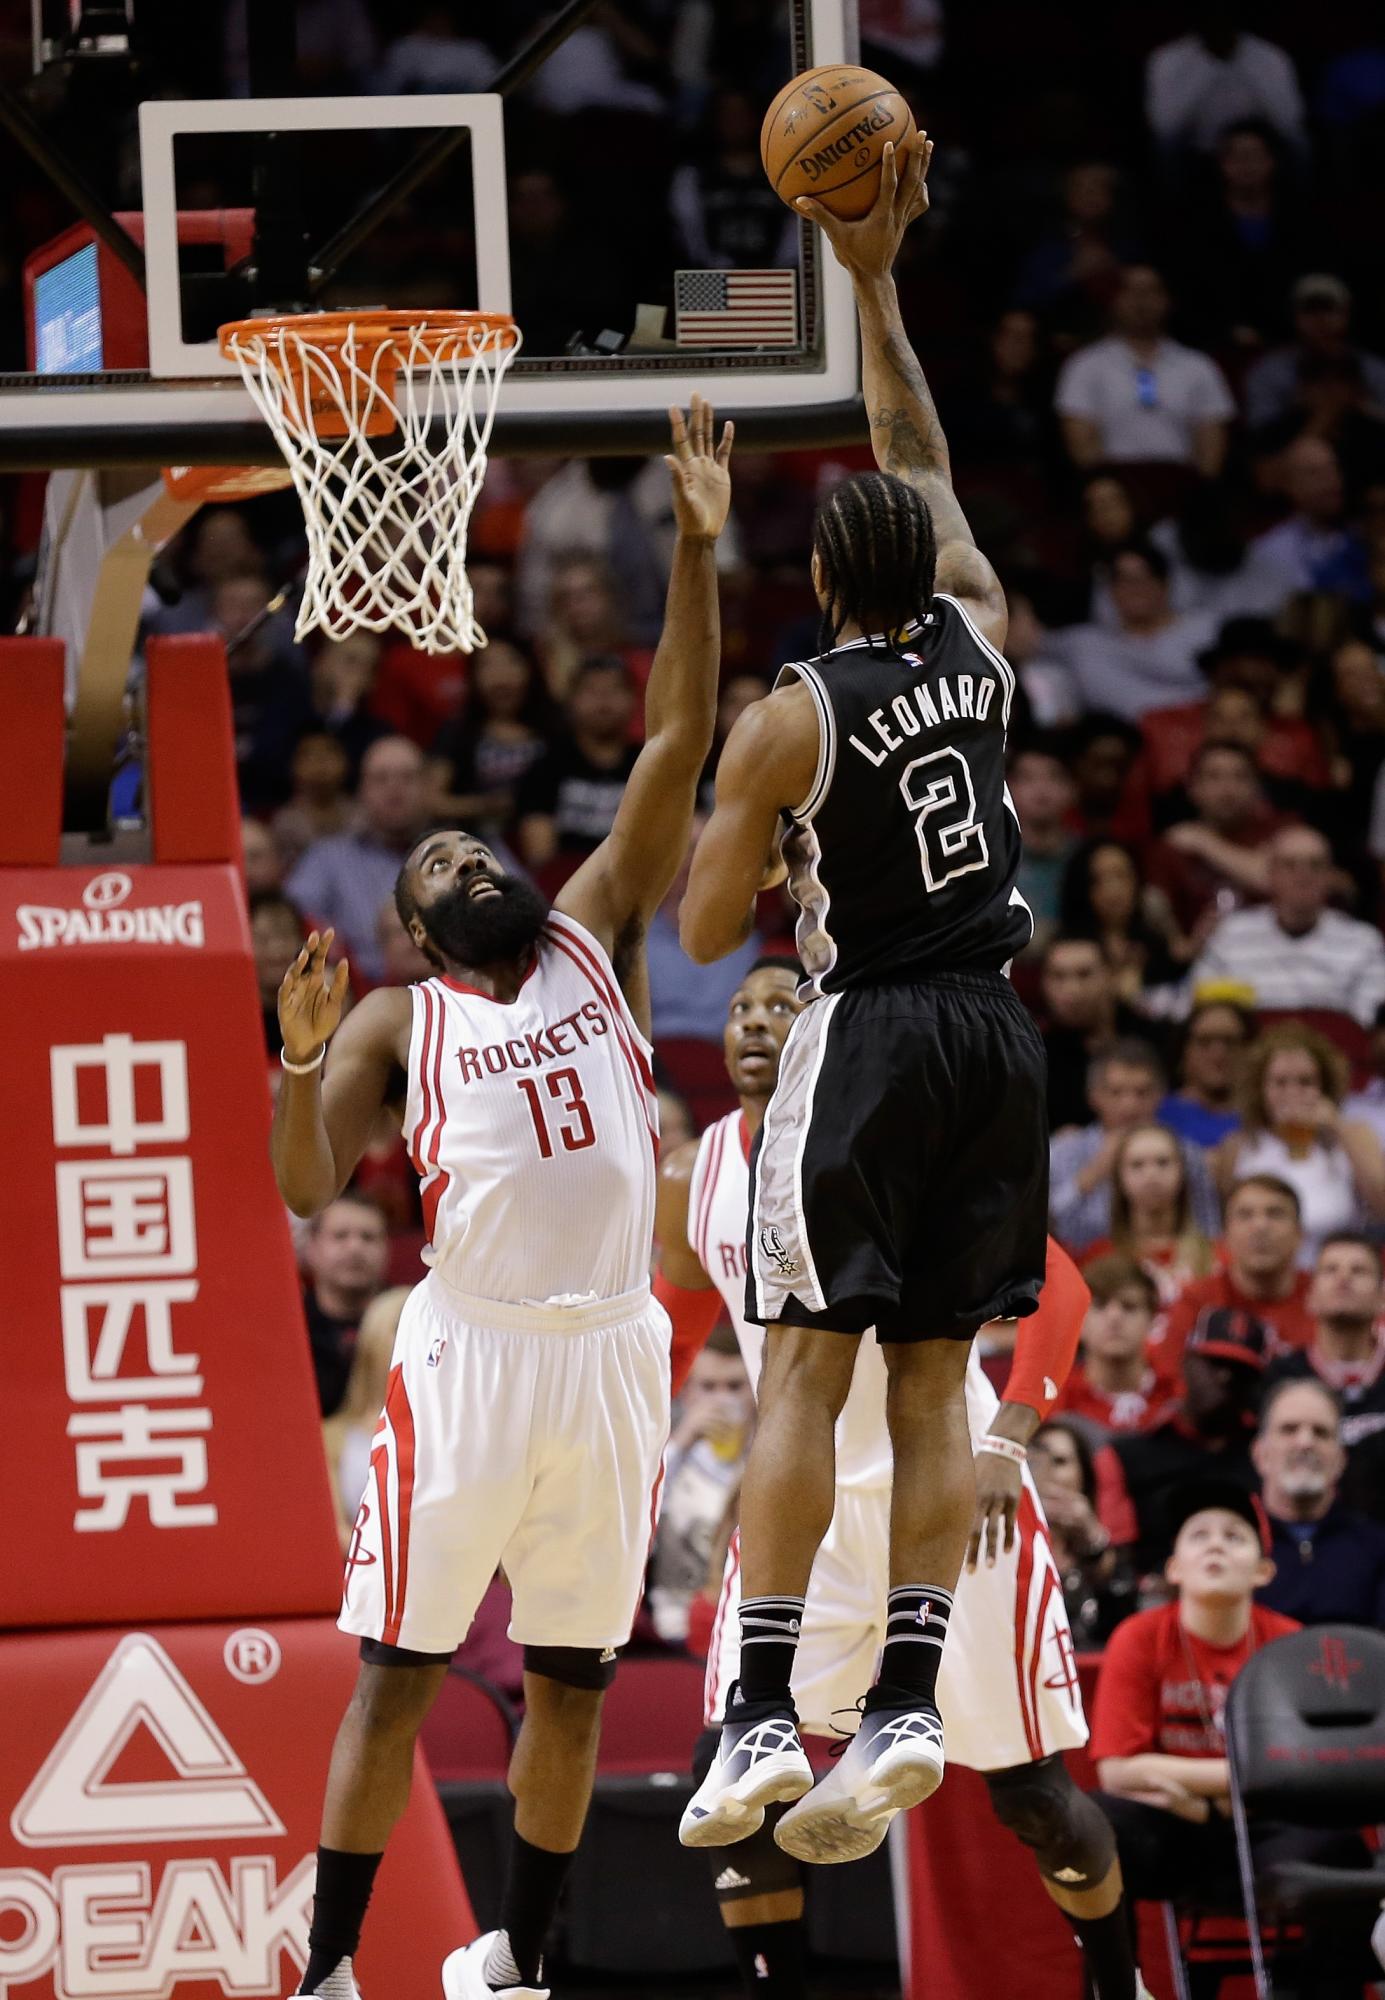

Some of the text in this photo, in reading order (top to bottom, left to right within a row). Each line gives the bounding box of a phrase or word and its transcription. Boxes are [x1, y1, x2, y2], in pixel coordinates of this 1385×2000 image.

[848, 674, 996, 768] LEONARD
[899, 745, 990, 893] 2
[15, 899, 206, 952] SPALDING
[455, 1001, 608, 1085] ROCKETS
[516, 1066, 597, 1161] 13
[49, 1032, 219, 1533] 中国匹克
[0, 1855, 318, 2000] PEAK
